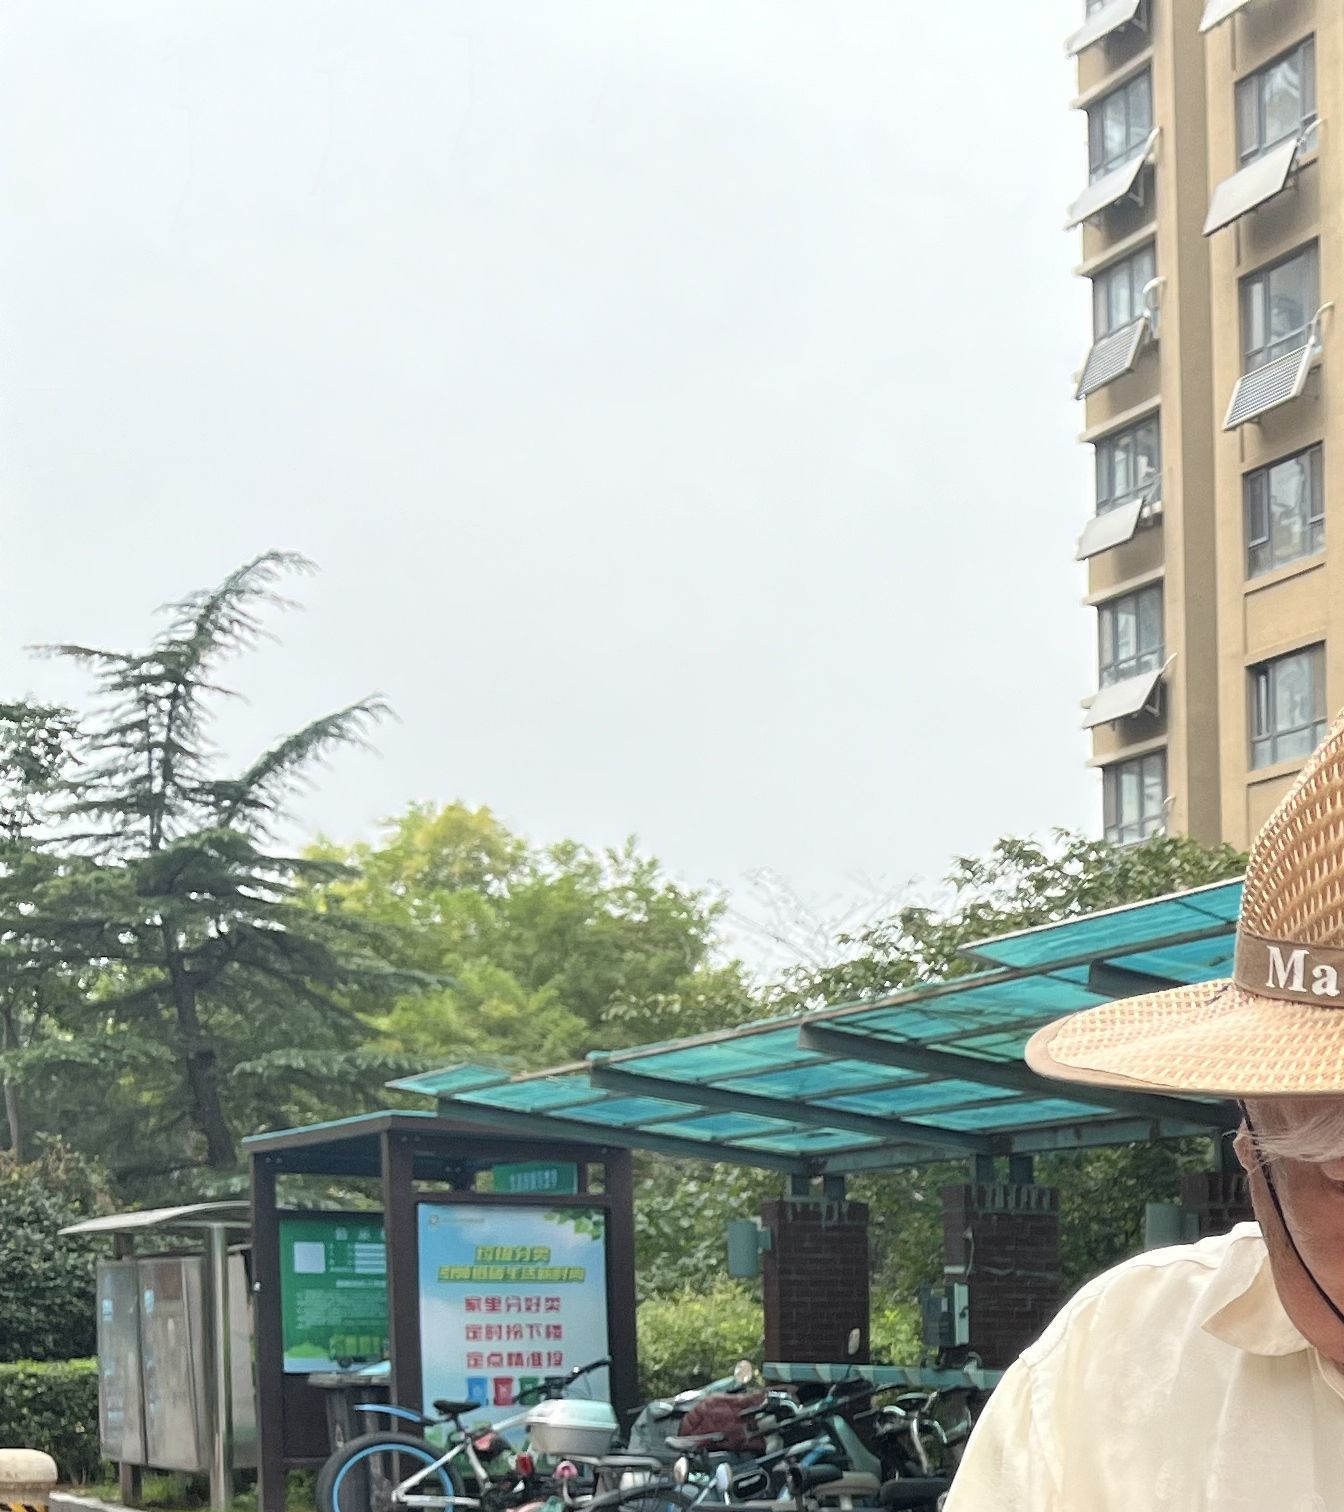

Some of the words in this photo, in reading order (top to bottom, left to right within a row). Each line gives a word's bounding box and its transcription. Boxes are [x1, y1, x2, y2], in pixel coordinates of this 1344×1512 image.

[464, 1295, 561, 1313] 家里分好类
[465, 1323, 563, 1341] 定时拎下楼
[466, 1351, 564, 1369] 定点精准投
